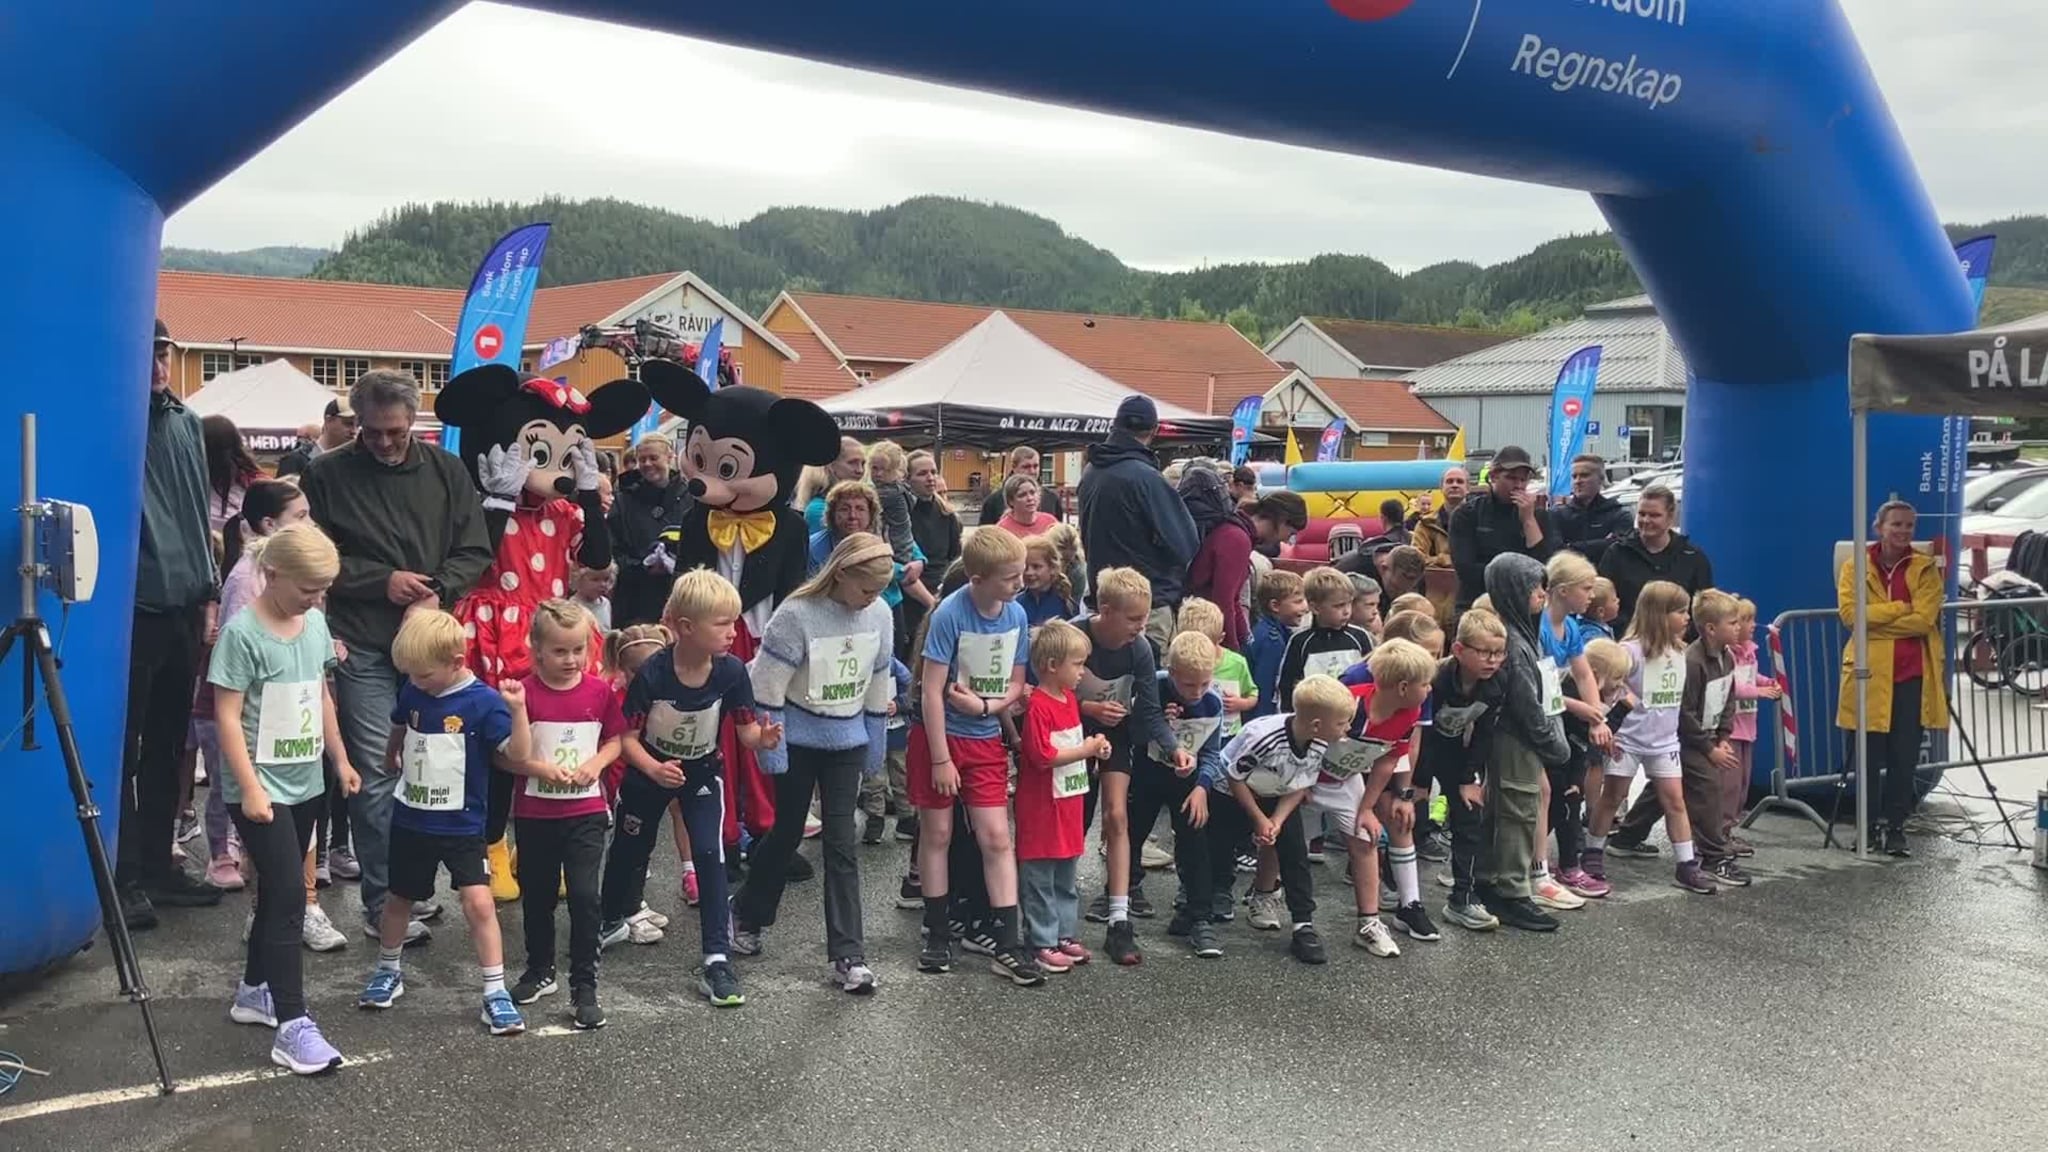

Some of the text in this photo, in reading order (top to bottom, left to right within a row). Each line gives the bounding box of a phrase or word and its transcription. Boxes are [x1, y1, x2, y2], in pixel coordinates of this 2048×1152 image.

[1511, 33, 1682, 109] Regnskap
[1968, 336, 2013, 388] PÅ
[1588, 423, 1597, 433] P
[249, 435, 280, 450] MED
[1938, 418, 1951, 492] Eiendom
[1920, 452, 1933, 493] Bank
[837, 657, 858, 678] 79
[990, 655, 1002, 675] 5
[1662, 672, 1677, 690] 50
[300, 708, 312, 734] 2
[672, 727, 697, 742] 61
[273, 737, 314, 758] KIWI
[414, 759, 423, 781] 1
[554, 748, 578, 771] 23
[430, 786, 450, 796] mini
[430, 795, 448, 807] pris
